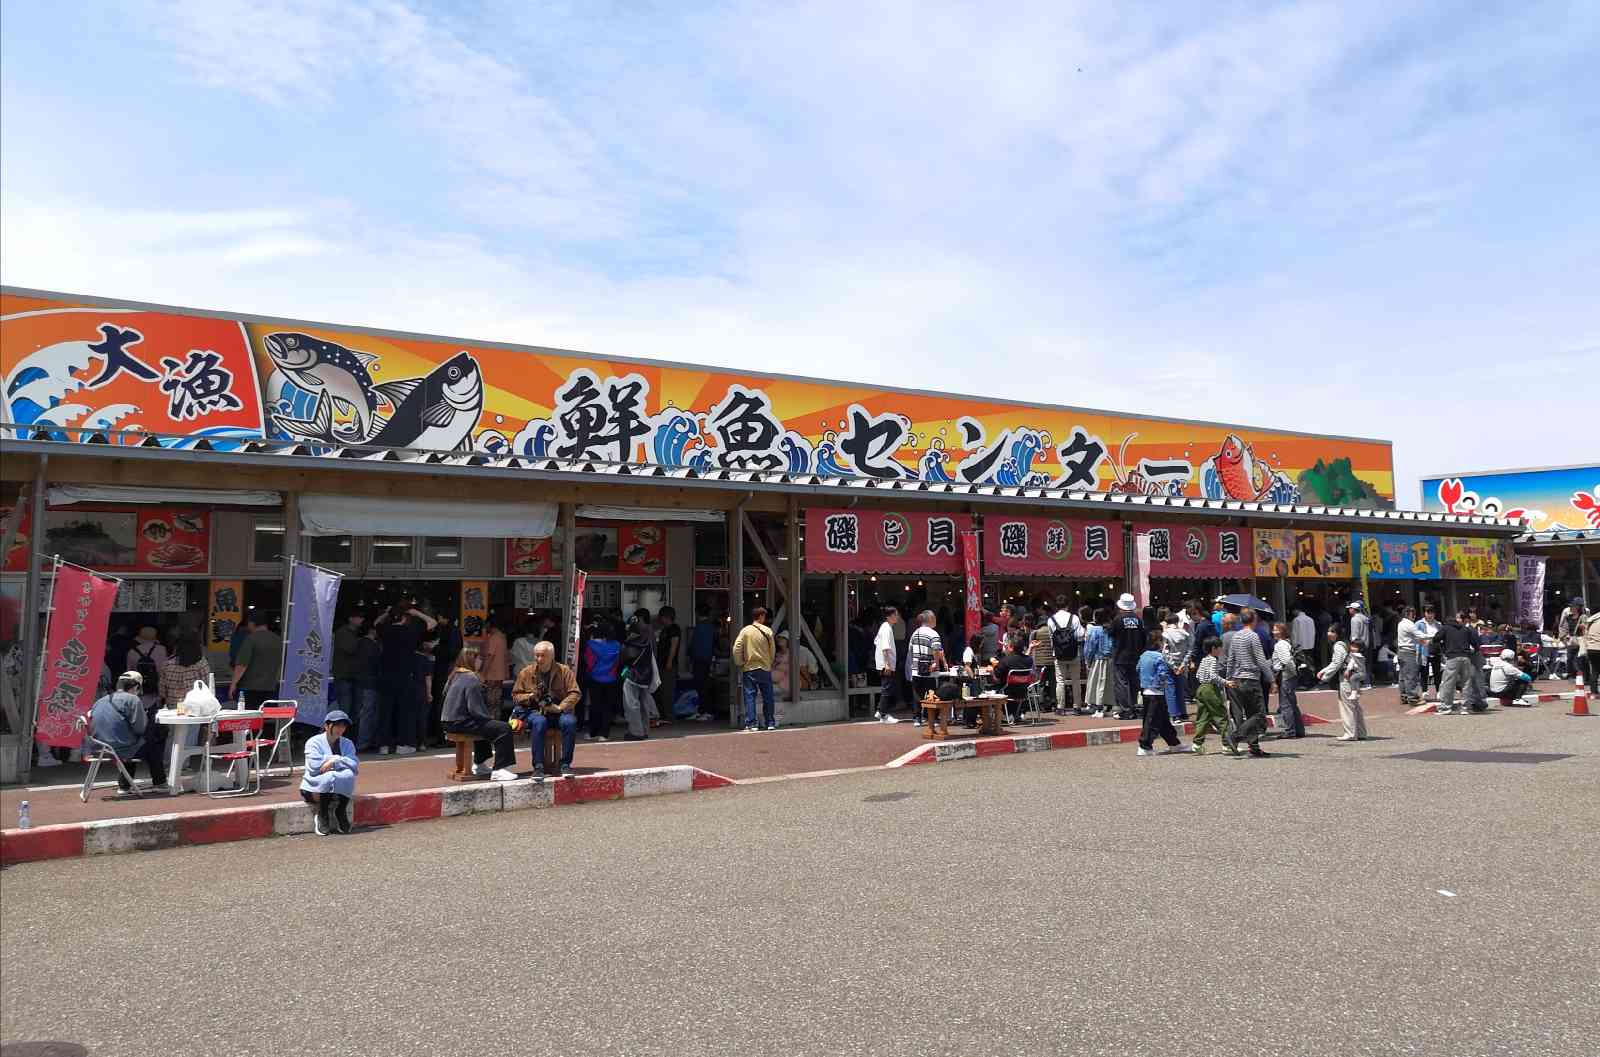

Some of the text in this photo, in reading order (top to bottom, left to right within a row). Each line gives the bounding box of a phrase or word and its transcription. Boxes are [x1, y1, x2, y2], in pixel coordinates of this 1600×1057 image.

[88, 323, 242, 420] 大漁
[556, 373, 1190, 490] 鮮魚センター
